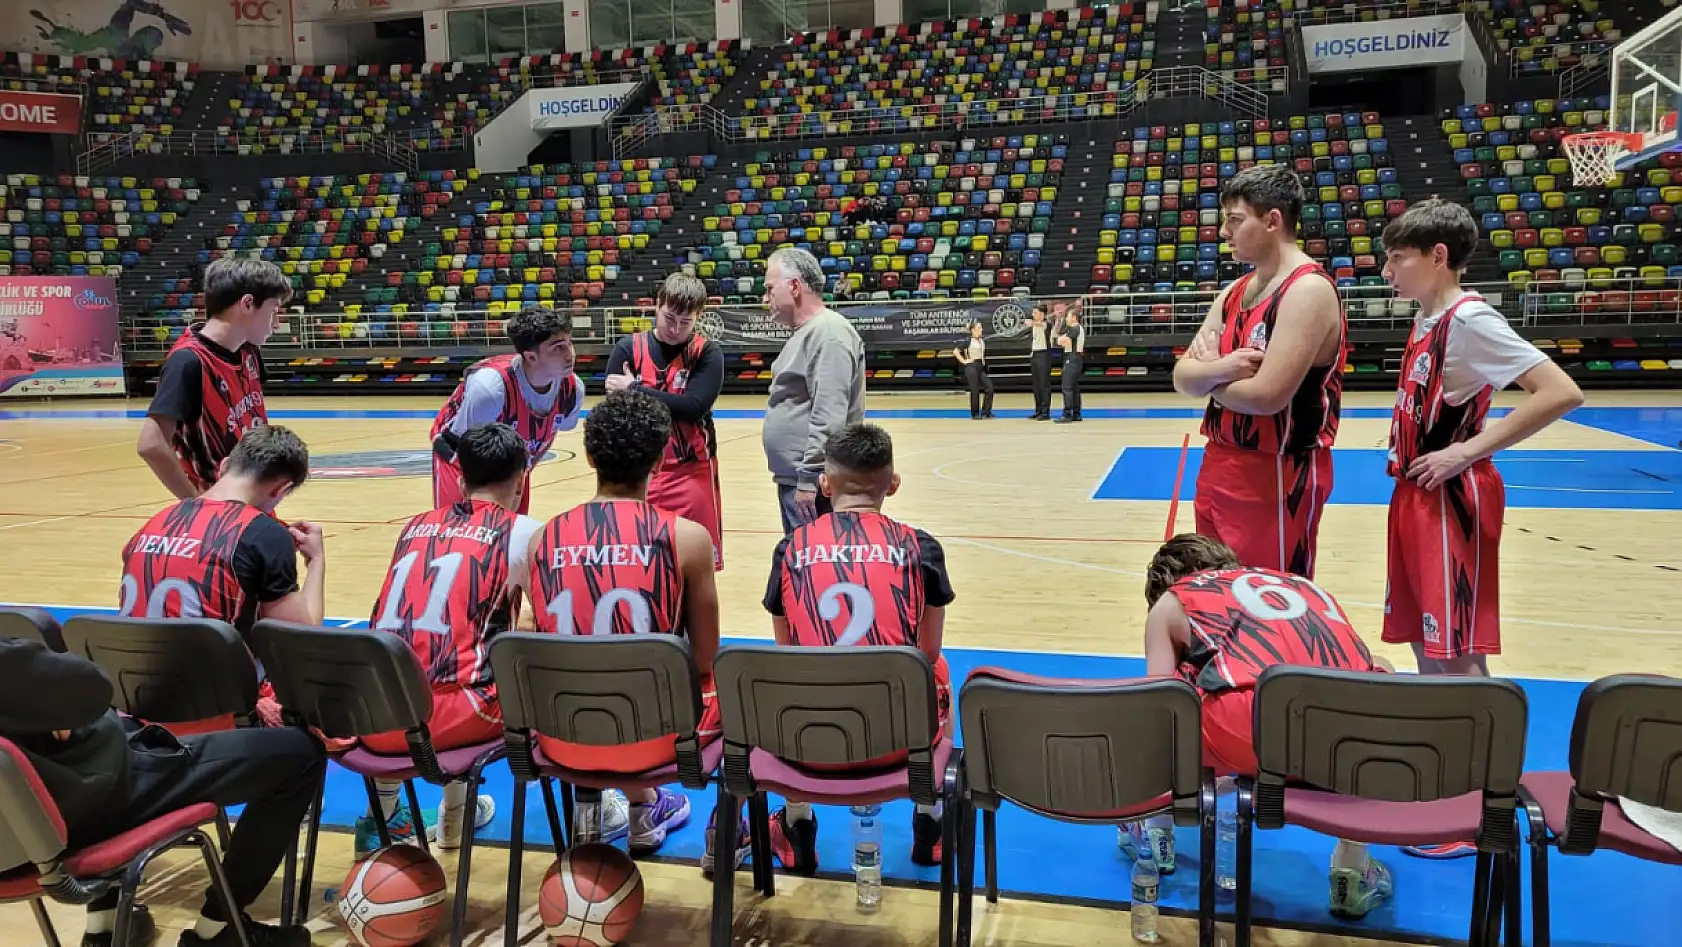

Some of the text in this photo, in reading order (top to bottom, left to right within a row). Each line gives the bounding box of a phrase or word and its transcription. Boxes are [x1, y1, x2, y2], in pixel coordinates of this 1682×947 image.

[1314, 28, 1450, 59] HOŞGELDİNİZ
[0, 103, 57, 124] OME
[540, 94, 625, 117] HOŞGELDİN
[23, 285, 39, 298] VE
[41, 285, 72, 298] SPOR
[901, 319, 911, 328] VE
[132, 532, 203, 559] DENİZ
[552, 543, 653, 569] EYMEN
[794, 543, 906, 568] HAKTAN
[379, 551, 463, 635] 11
[546, 587, 651, 635] 10
[818, 582, 875, 646] 2
